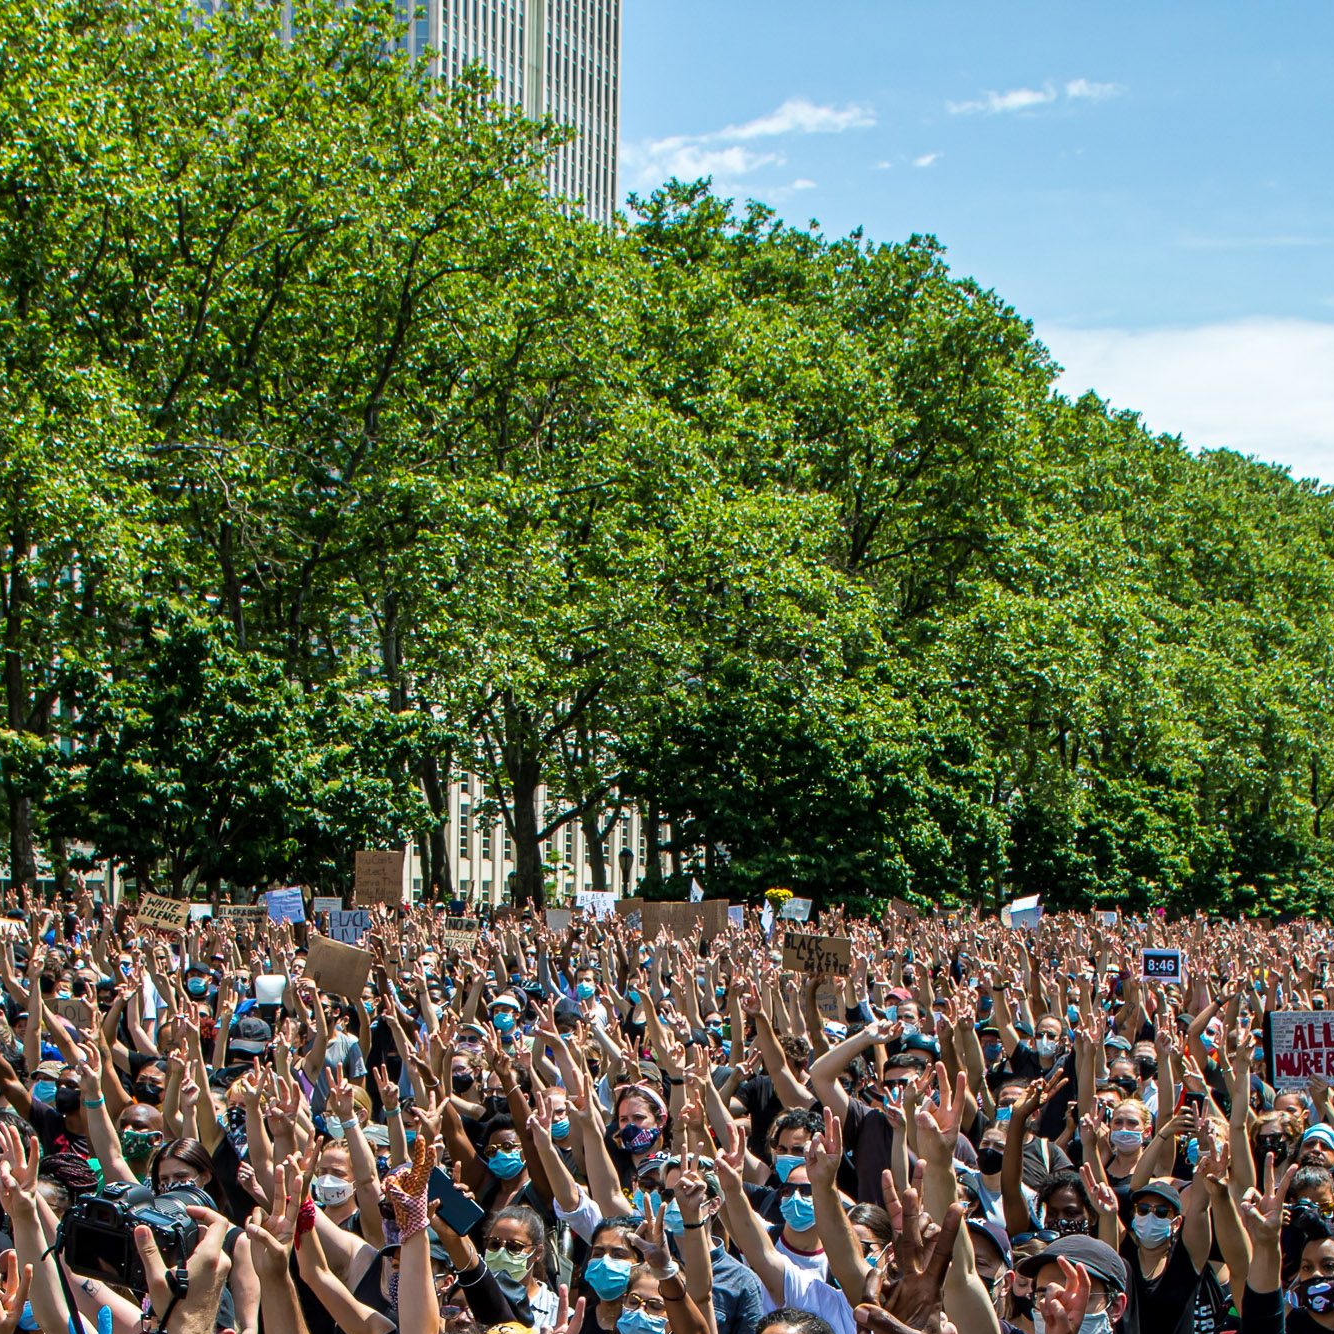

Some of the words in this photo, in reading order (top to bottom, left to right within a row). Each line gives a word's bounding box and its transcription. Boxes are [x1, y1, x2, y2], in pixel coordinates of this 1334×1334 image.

[146, 897, 181, 913] WHITE
[580, 893, 606, 904] BLACK
[140, 906, 182, 925] SILENCE
[330, 911, 369, 927] BLACK
[448, 918, 463, 930] NO
[784, 933, 823, 951] BLACK
[796, 944, 839, 961] LIVES
[804, 960, 849, 976] MATTER
[1148, 959, 1175, 971] 8:46
